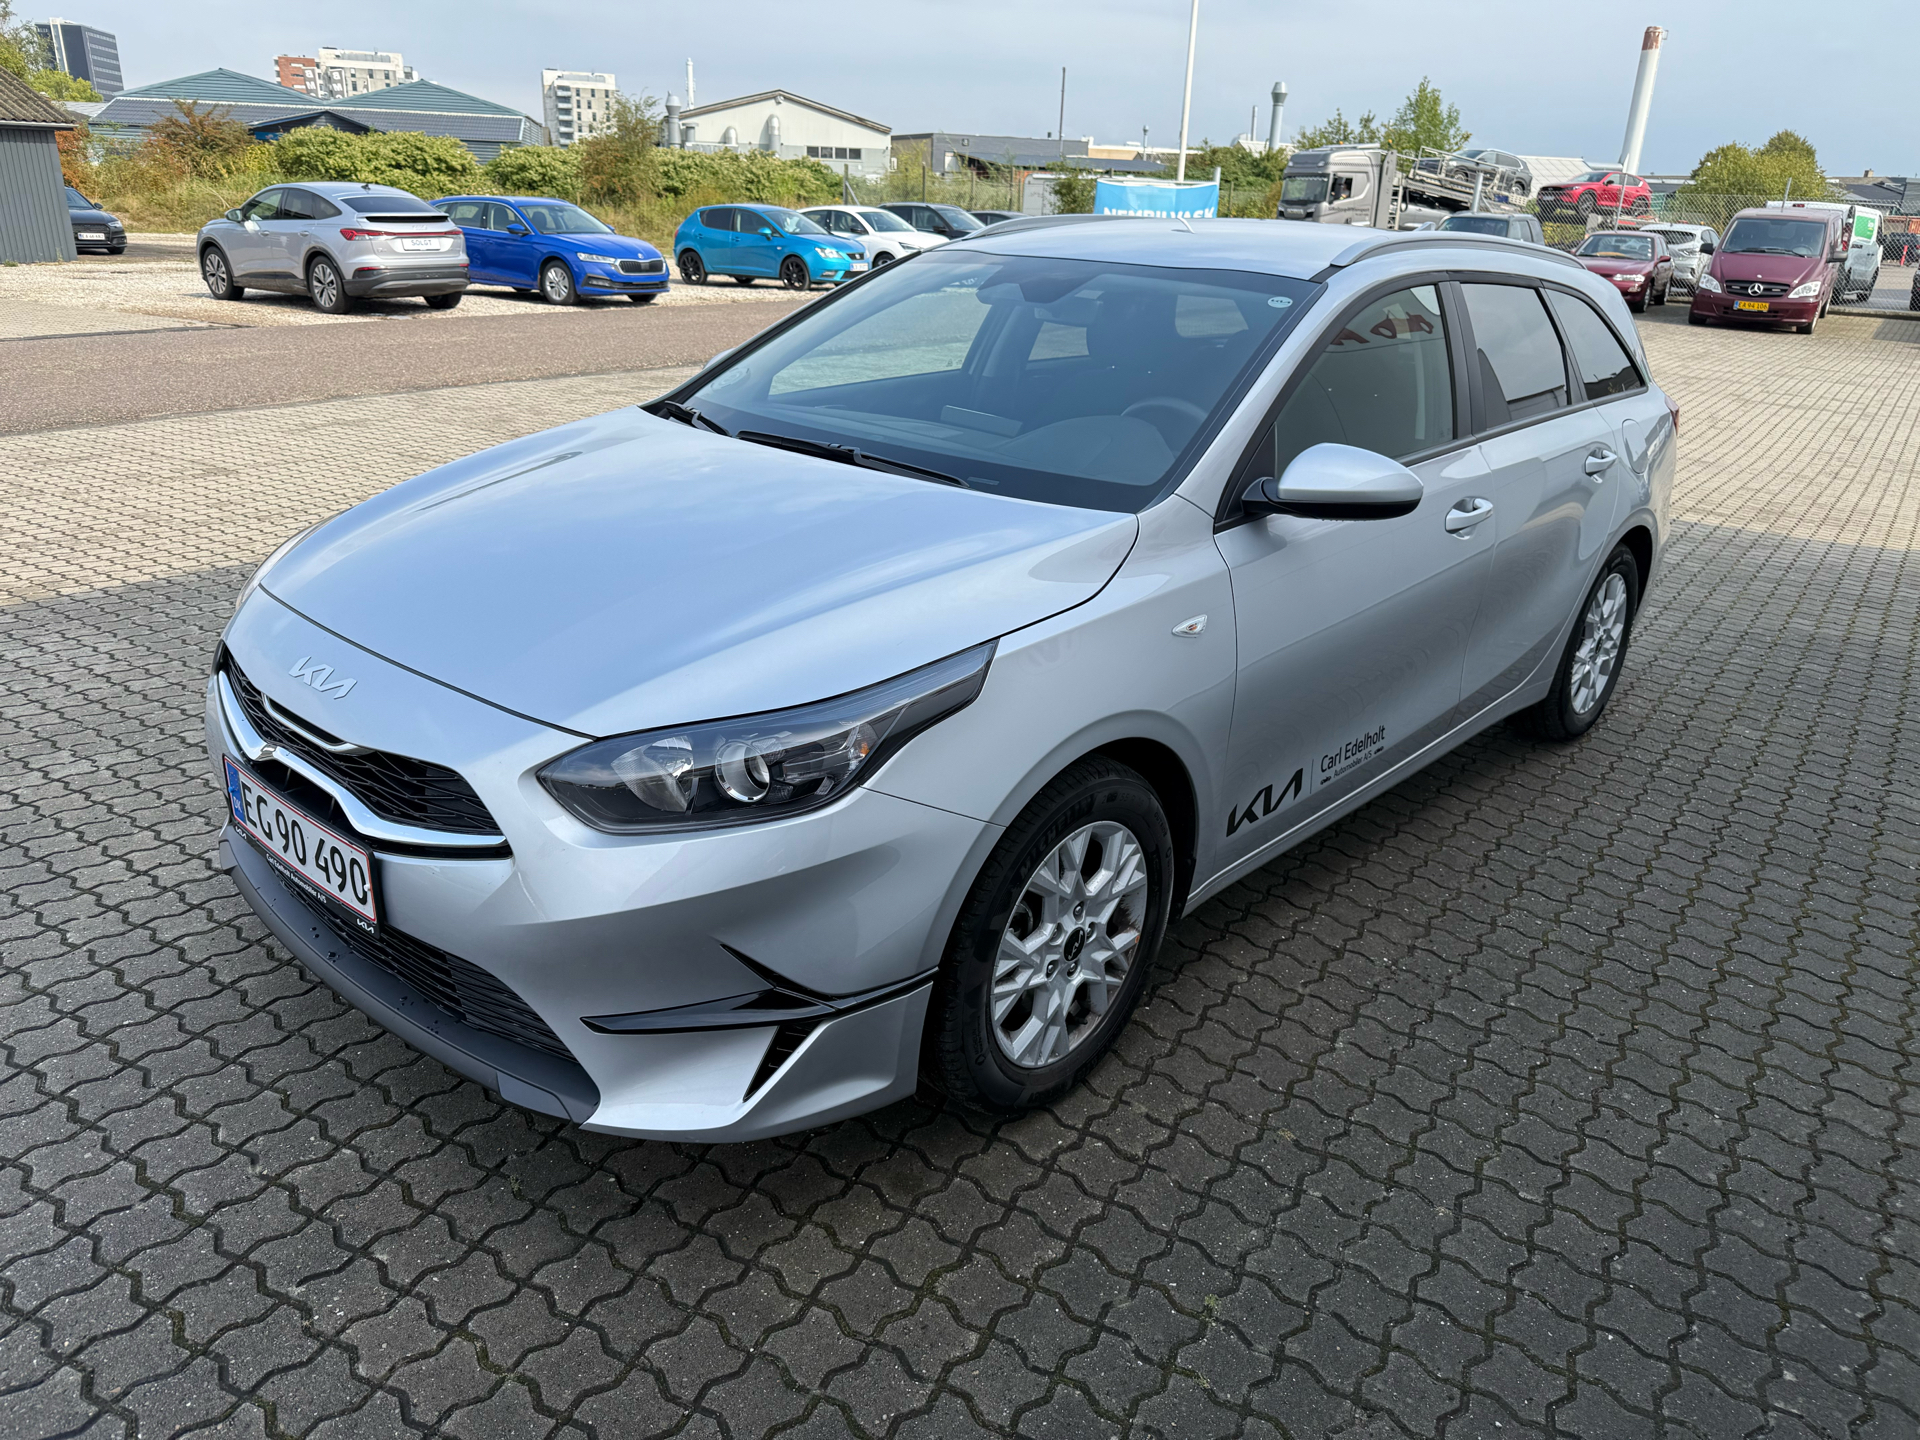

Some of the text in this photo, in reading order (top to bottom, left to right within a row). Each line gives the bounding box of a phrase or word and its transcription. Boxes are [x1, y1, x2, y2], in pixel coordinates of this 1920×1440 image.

[288, 655, 358, 700] KIA
[1320, 725, 1385, 773] Carl Edelholt
[1333, 749, 1373, 778] Automobiler A/S
[1226, 768, 1304, 837] KIA
[235, 825, 247, 840] KIA
[241, 780, 368, 905] EG 90 490
[357, 918, 374, 934] KIA
